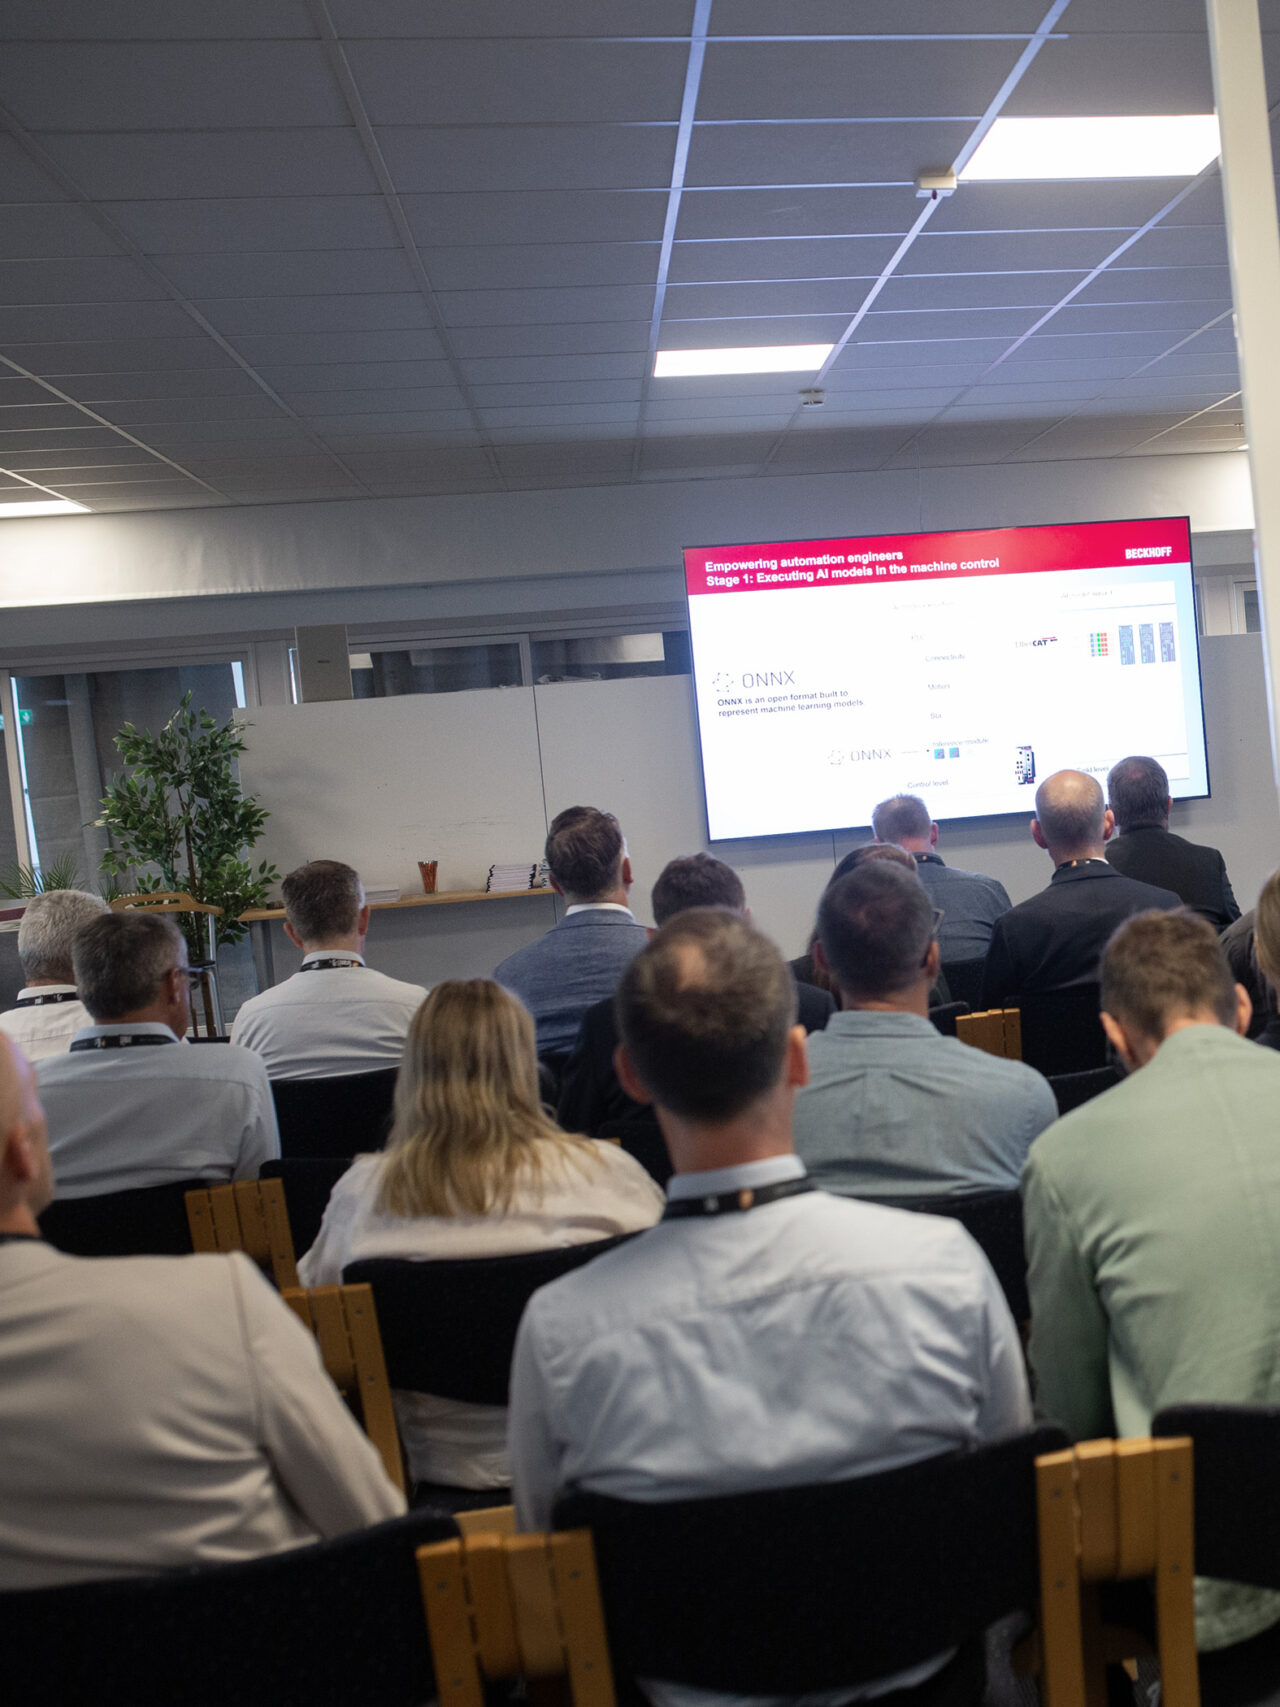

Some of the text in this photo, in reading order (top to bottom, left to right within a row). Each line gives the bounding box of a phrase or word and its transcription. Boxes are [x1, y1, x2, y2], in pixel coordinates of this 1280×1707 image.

[705, 551, 904, 573] Empowering automation engineers
[1125, 546, 1172, 560] BECKHOFF
[706, 557, 1000, 587] Stage 1: Executing AI models in the machine control
[742, 670, 796, 689] ONNX
[717, 690, 849, 707] ONNX is an open format built to
[718, 706, 759, 718] represent
[760, 703, 796, 714] machine
[797, 700, 832, 712] learning
[850, 748, 892, 762] ONNX
